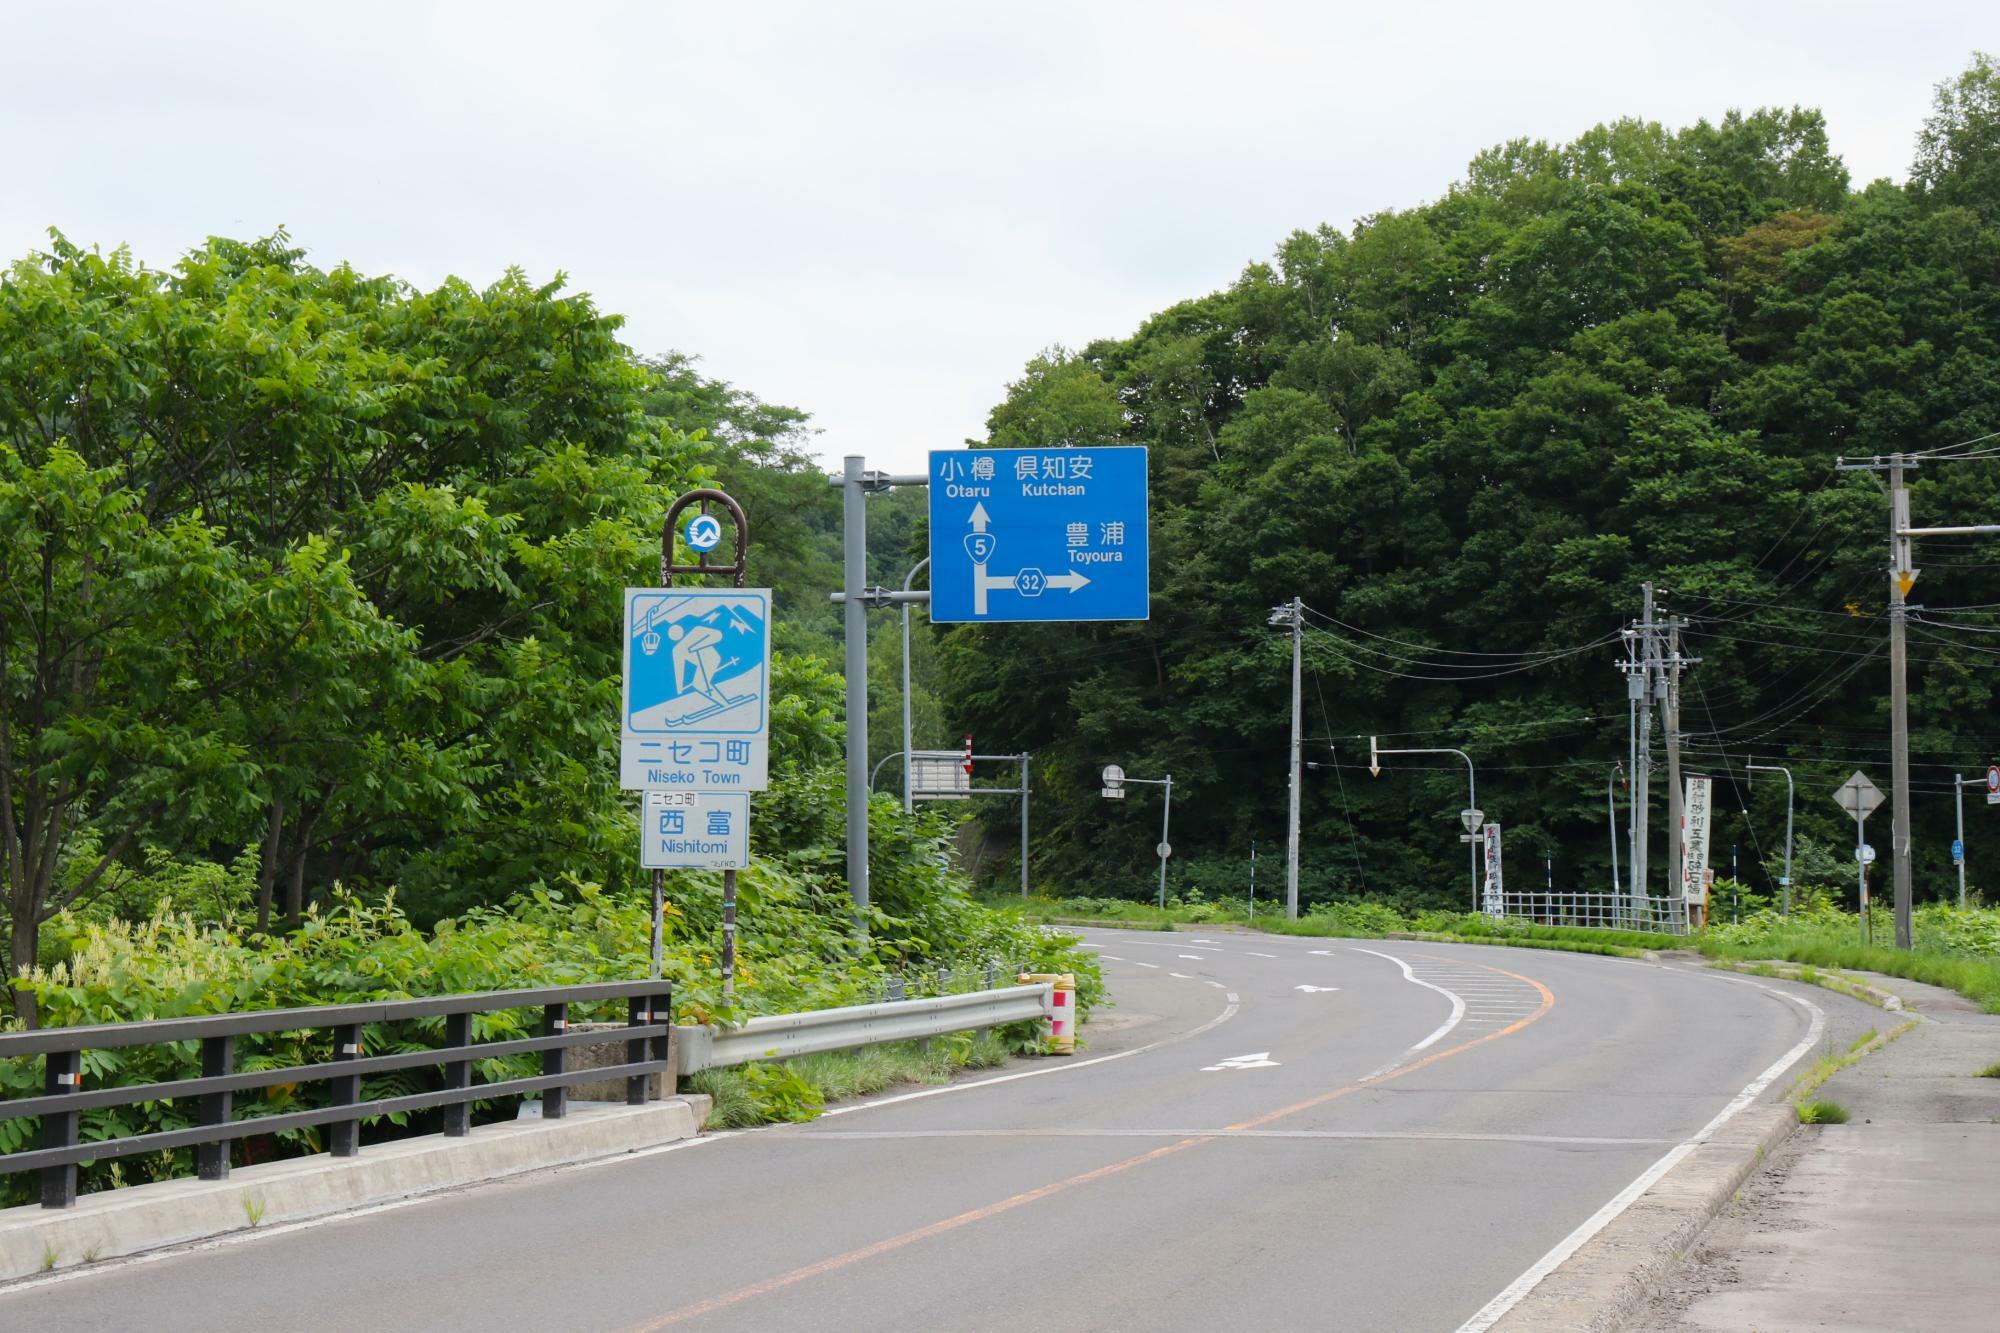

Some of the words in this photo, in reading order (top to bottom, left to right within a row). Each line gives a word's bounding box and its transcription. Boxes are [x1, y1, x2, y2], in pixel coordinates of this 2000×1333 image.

[940, 456, 996, 482] 小樽
[1014, 454, 1094, 481] 倶知安
[946, 484, 991, 498] Otaru
[1022, 483, 1086, 497] Kutchan
[1065, 521, 1125, 547] 豊浦
[974, 538, 987, 556] 5
[1067, 549, 1124, 565] Toyoura
[1021, 574, 1040, 590] 32
[638, 739, 752, 766] ニセコ町
[647, 769, 695, 784] Niseko
[702, 769, 741, 784] Town
[651, 792, 696, 807] ニセコ町
[659, 809, 732, 836] 西富
[661, 839, 728, 854] Nishitomi
